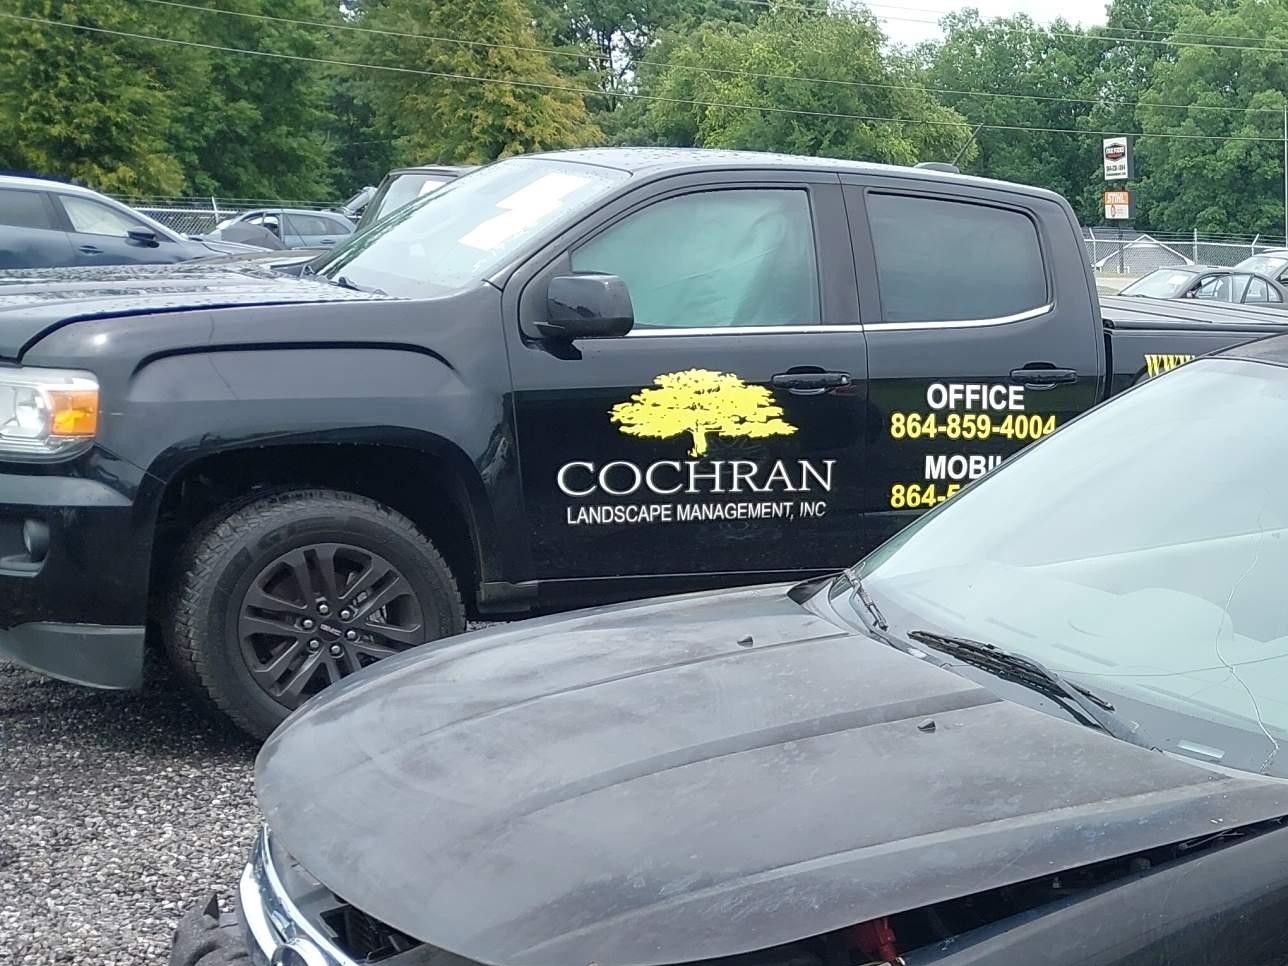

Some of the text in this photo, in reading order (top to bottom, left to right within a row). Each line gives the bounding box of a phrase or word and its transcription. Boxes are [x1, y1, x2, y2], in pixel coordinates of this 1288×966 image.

[926, 383, 1025, 411] OFFICE
[890, 413, 1057, 440] 864-859-4004
[556, 459, 836, 497] COCHRAN
[567, 502, 827, 525] LANDSCAPE MANAGEMENT, INC
